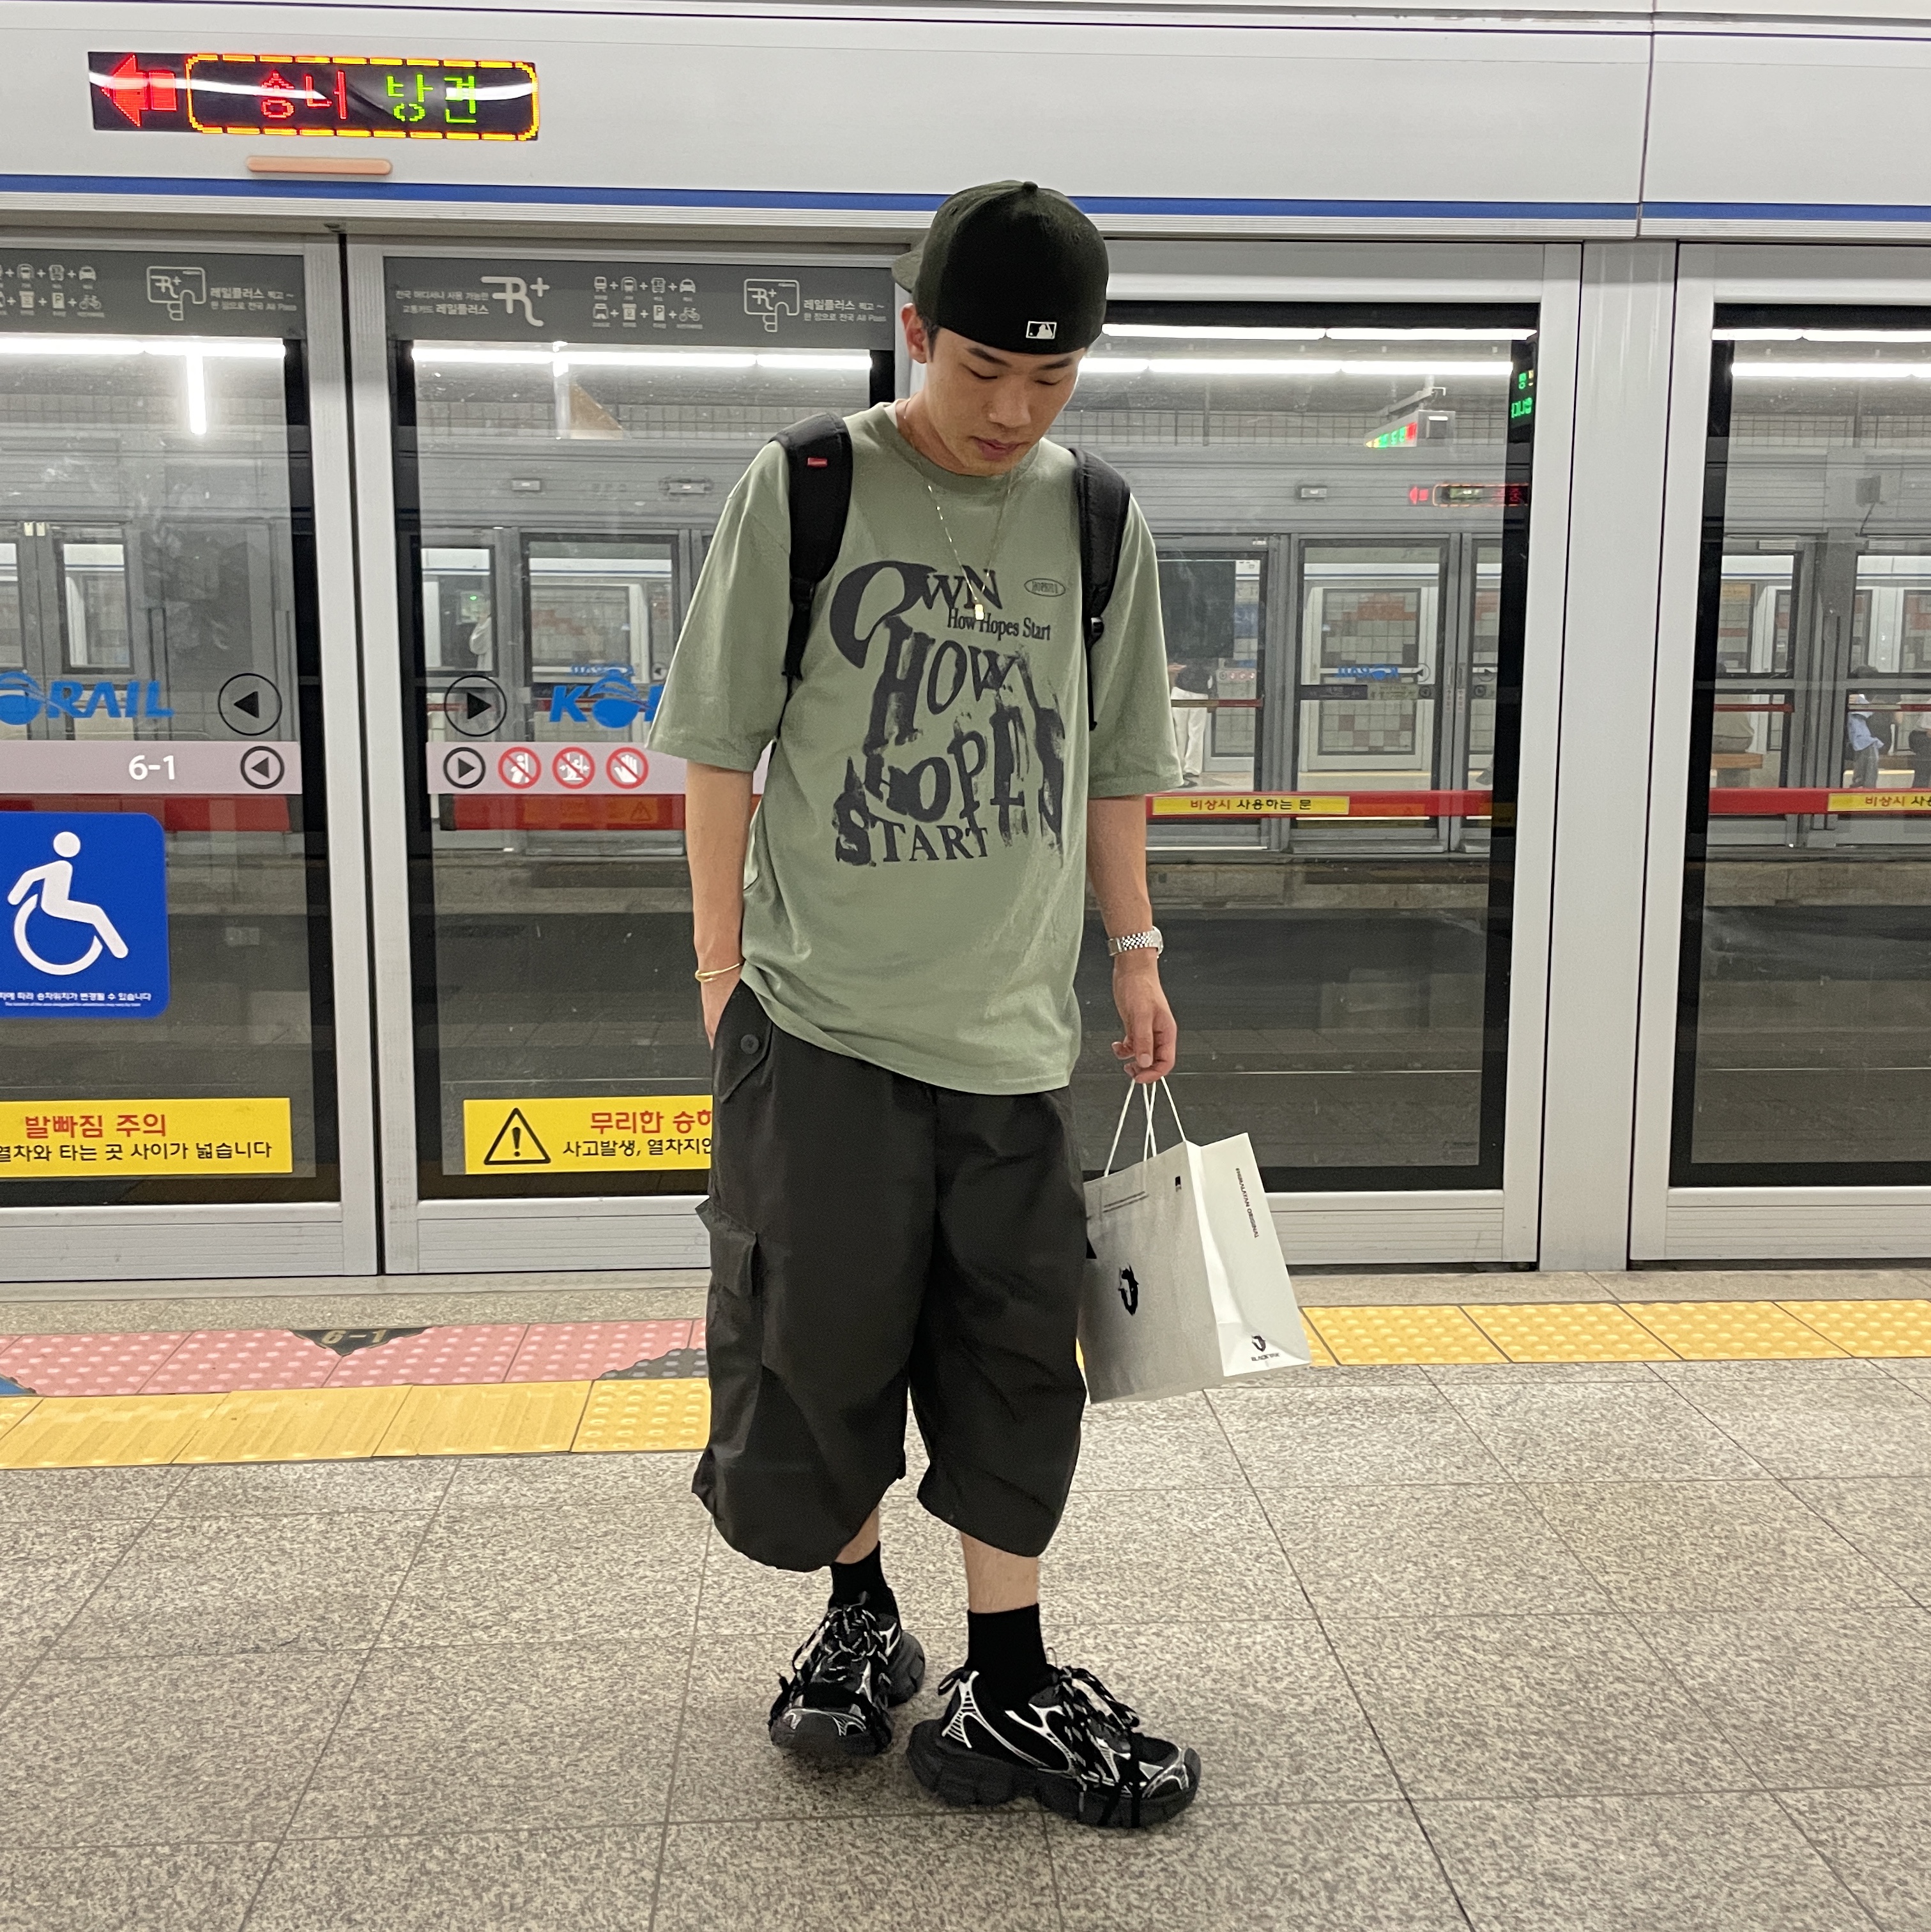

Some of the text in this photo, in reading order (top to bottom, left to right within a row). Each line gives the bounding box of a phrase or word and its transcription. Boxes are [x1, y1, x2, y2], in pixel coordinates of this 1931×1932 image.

[436, 304, 489, 315] 레일플러스
[804, 299, 855, 310] 레일플러스
[947, 607, 1051, 641] How Hopes Start
[128, 754, 175, 780] 6-1
[1190, 799, 1312, 810] 비상시 사용하는 문
[1865, 796, 1905, 807] 비상시
[25, 1113, 166, 1139] 발빠짐 주의
[590, 1110, 664, 1135] 무리한
[60, 1144, 97, 1162] 타는
[105, 1144, 123, 1161] 곳
[131, 1142, 188, 1160] 사이가
[197, 1141, 273, 1160] 넓습니다
[562, 1139, 641, 1157] 사고발생,
[321, 1329, 388, 1345] 6-1
